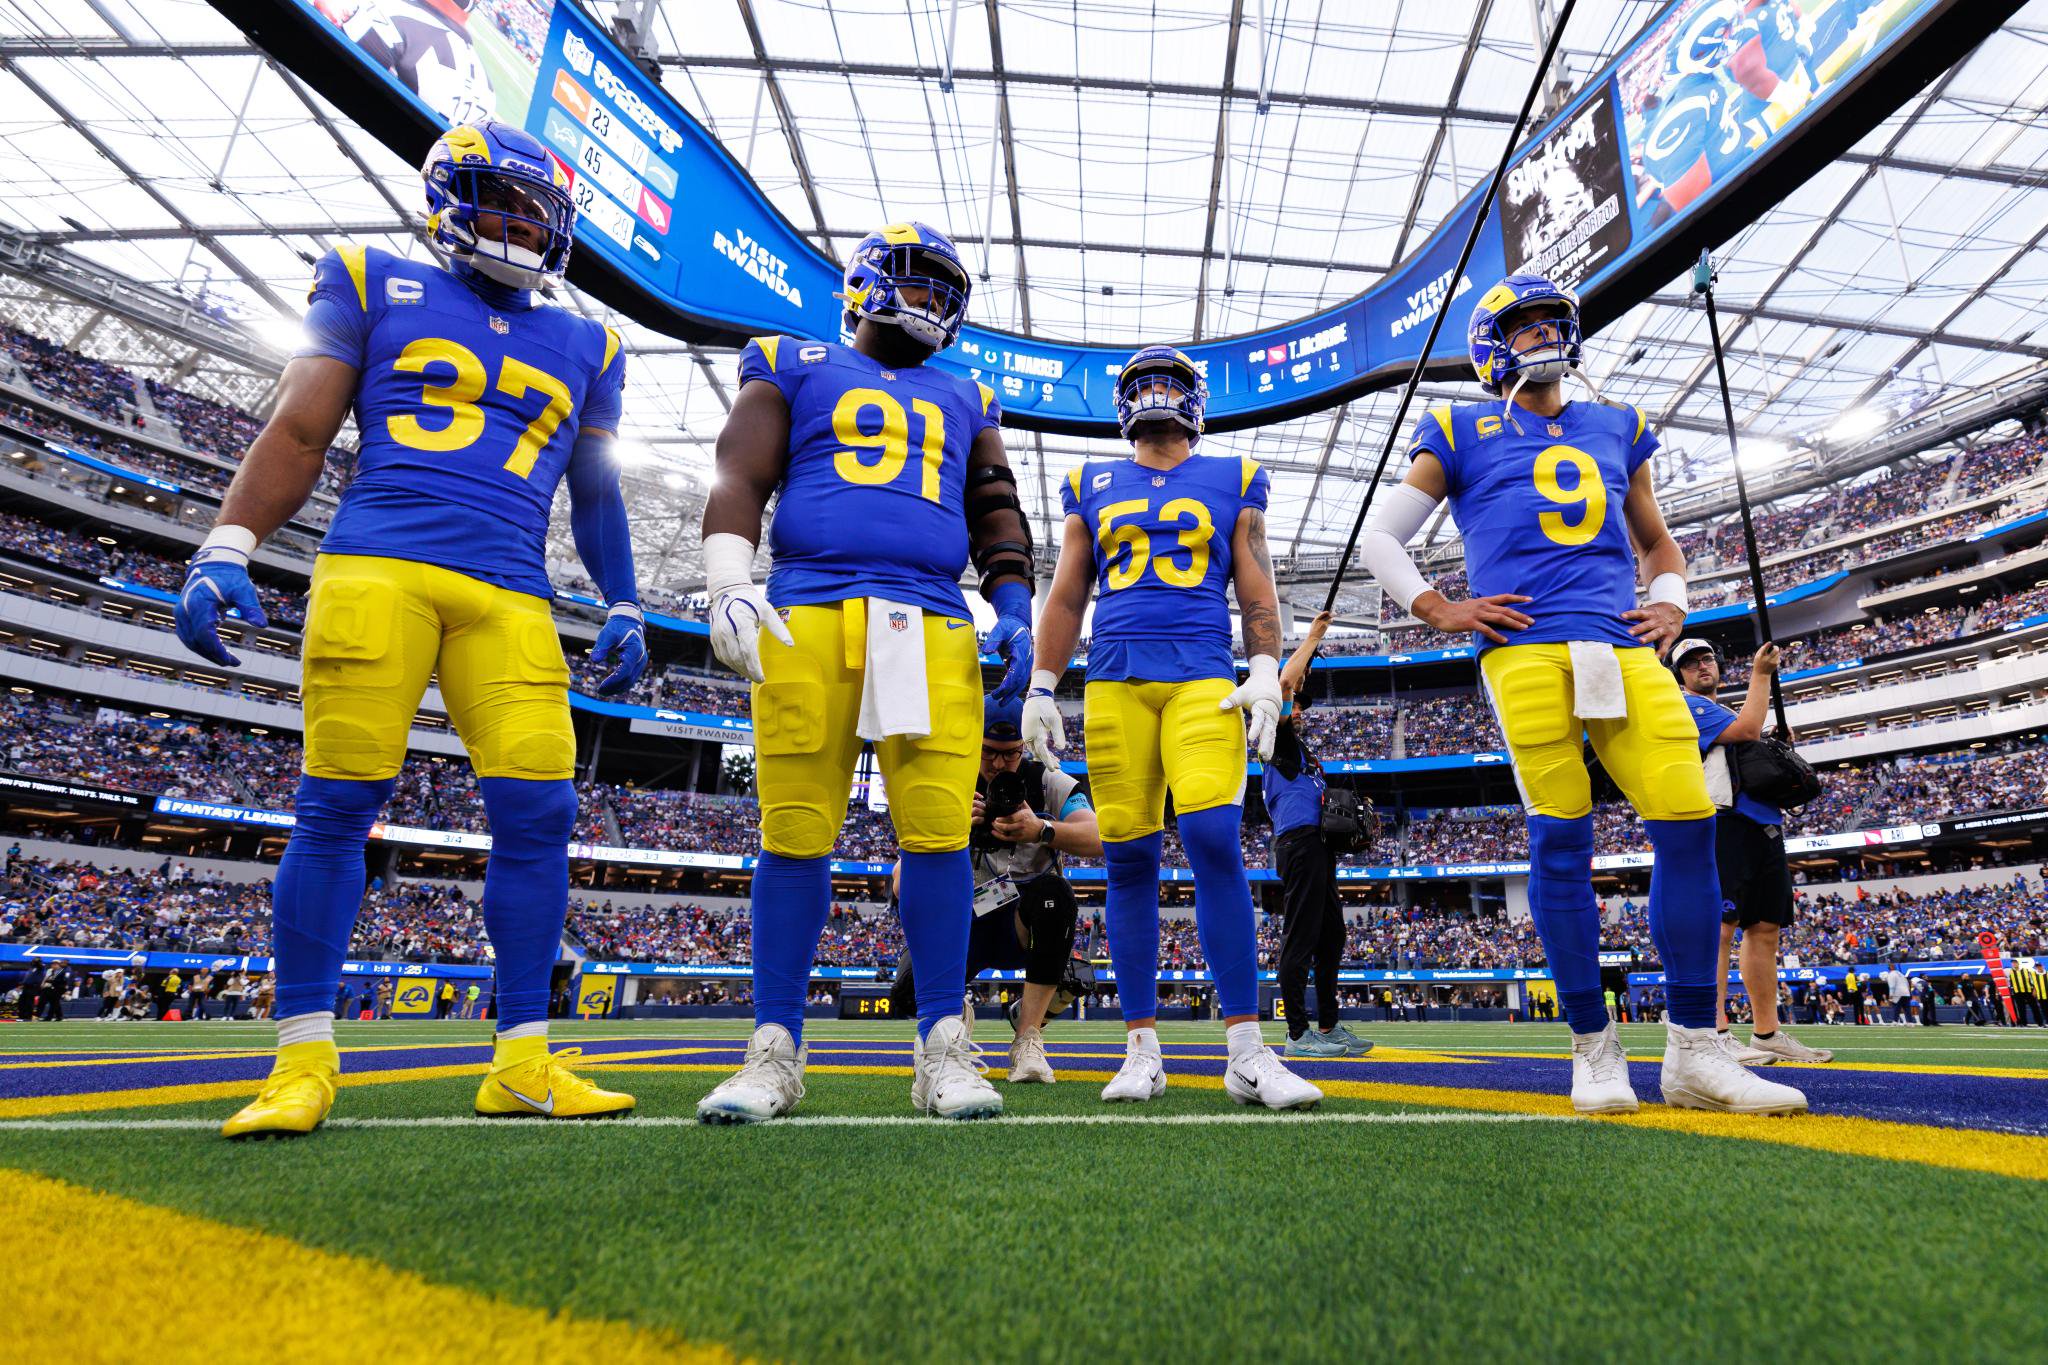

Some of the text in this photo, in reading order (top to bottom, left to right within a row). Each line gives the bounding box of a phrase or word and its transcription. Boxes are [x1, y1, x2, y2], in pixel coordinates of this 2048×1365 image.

[592, 108, 610, 136] 23
[585, 147, 602, 174] 45
[575, 183, 594, 212] 32
[713, 230, 802, 309] RWANDA
[736, 228, 788, 278] VISIT
[1543, 241, 1592, 281] OATHE
[1406, 268, 1458, 310] VISIT
[386, 337, 574, 480] 37
[831, 387, 946, 504] 91
[1533, 445, 1607, 546] 9
[1097, 497, 1216, 591] 53
[666, 724, 745, 741] VISIT RWANDA
[172, 802, 244, 820] FANTASY
[443, 834, 462, 844] 3/4
[1446, 866, 1496, 875] SCORES
[859, 998, 890, 1014] 1:19
